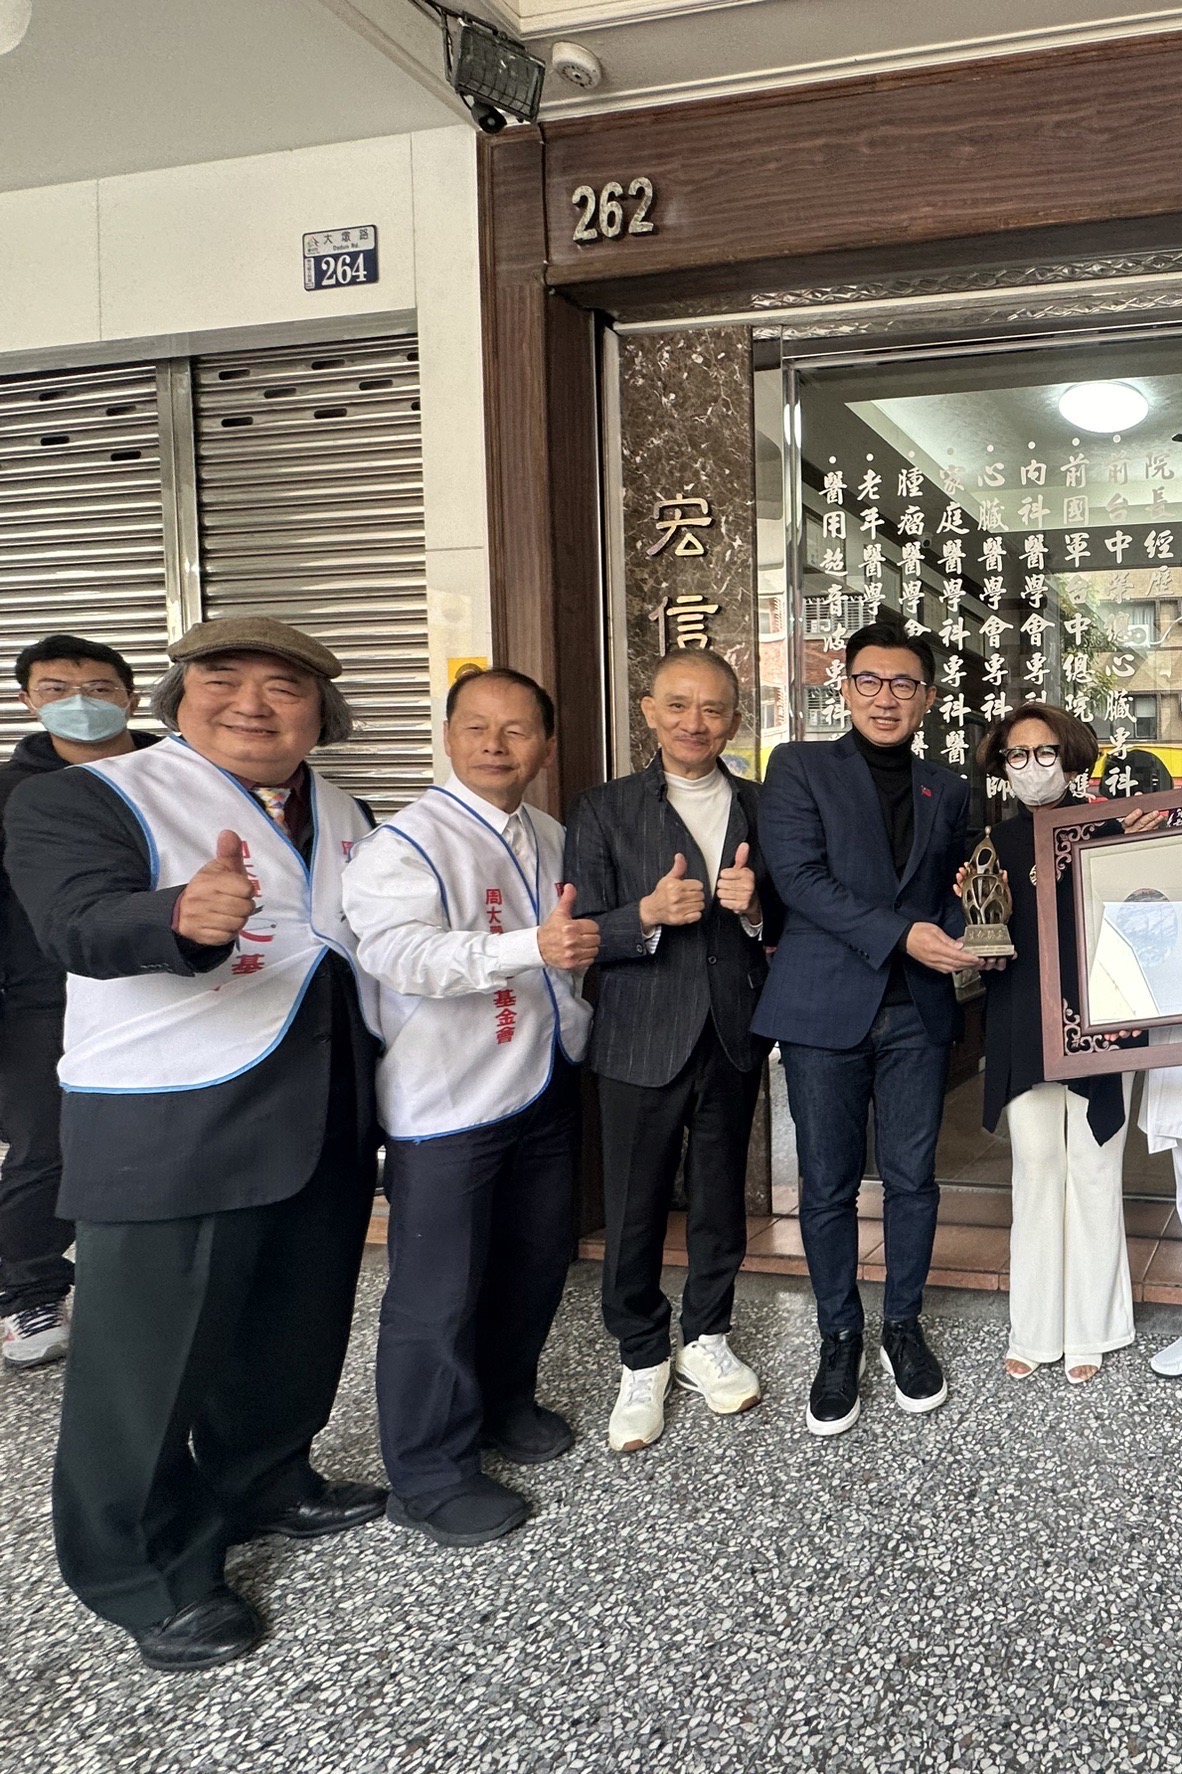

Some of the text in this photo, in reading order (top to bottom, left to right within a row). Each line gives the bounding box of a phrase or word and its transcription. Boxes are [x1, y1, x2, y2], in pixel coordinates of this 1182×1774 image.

[571, 176, 655, 241] 262
[321, 252, 367, 286] 264
[646, 492, 720, 656] 宏信
[857, 468, 886, 624] 老年醫學
